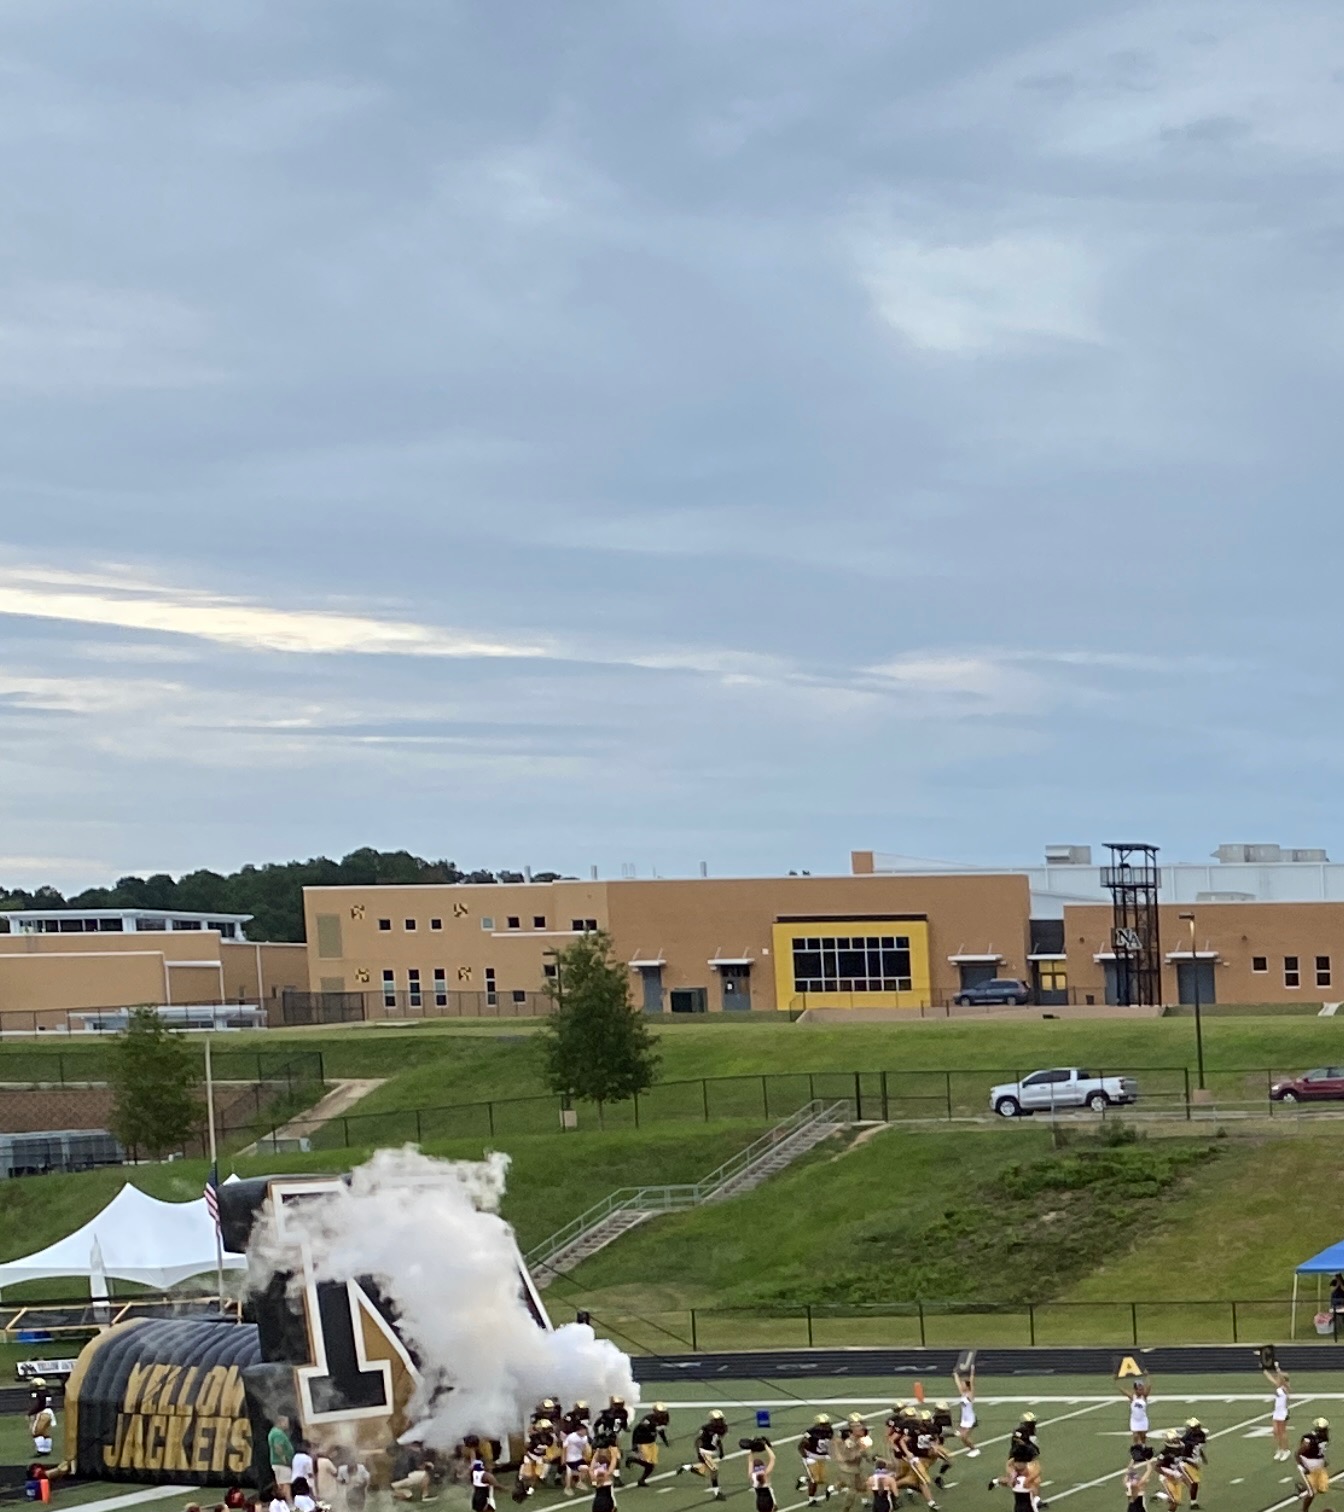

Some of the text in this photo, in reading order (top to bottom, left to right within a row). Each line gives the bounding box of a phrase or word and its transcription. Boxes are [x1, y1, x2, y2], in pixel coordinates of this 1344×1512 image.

[1116, 928, 1142, 949] NA
[1117, 1356, 1143, 1378] A
[123, 1362, 245, 1416] YELLOW
[103, 1413, 253, 1473] JACKETS
